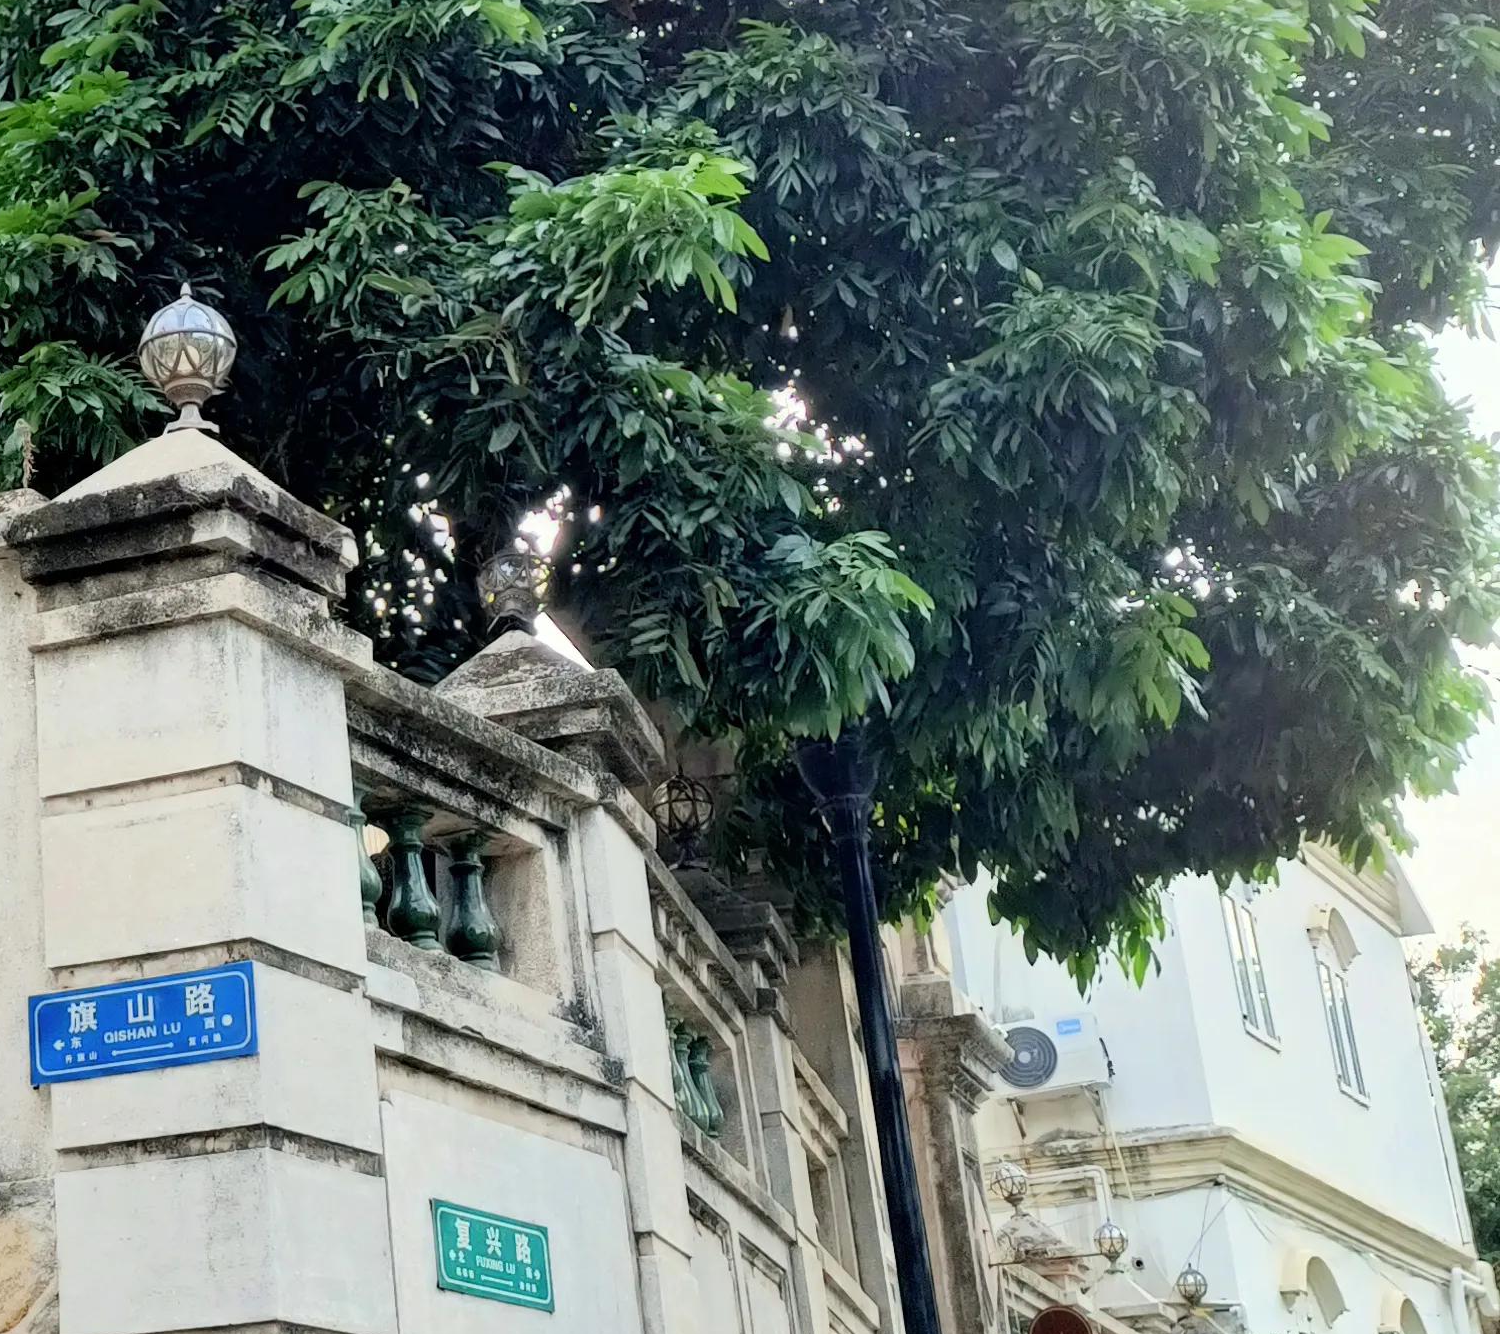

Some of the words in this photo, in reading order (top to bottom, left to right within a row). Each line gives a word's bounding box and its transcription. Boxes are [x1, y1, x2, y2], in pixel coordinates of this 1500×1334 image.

[67, 982, 216, 1035] 旗山路
[70, 1036, 82, 1049] 东
[104, 1024, 157, 1044] QISHAN
[163, 1021, 181, 1036] LU
[455, 1217, 532, 1265] 复兴路
[475, 1255, 504, 1273] FUXING
[505, 1262, 516, 1275] LU
